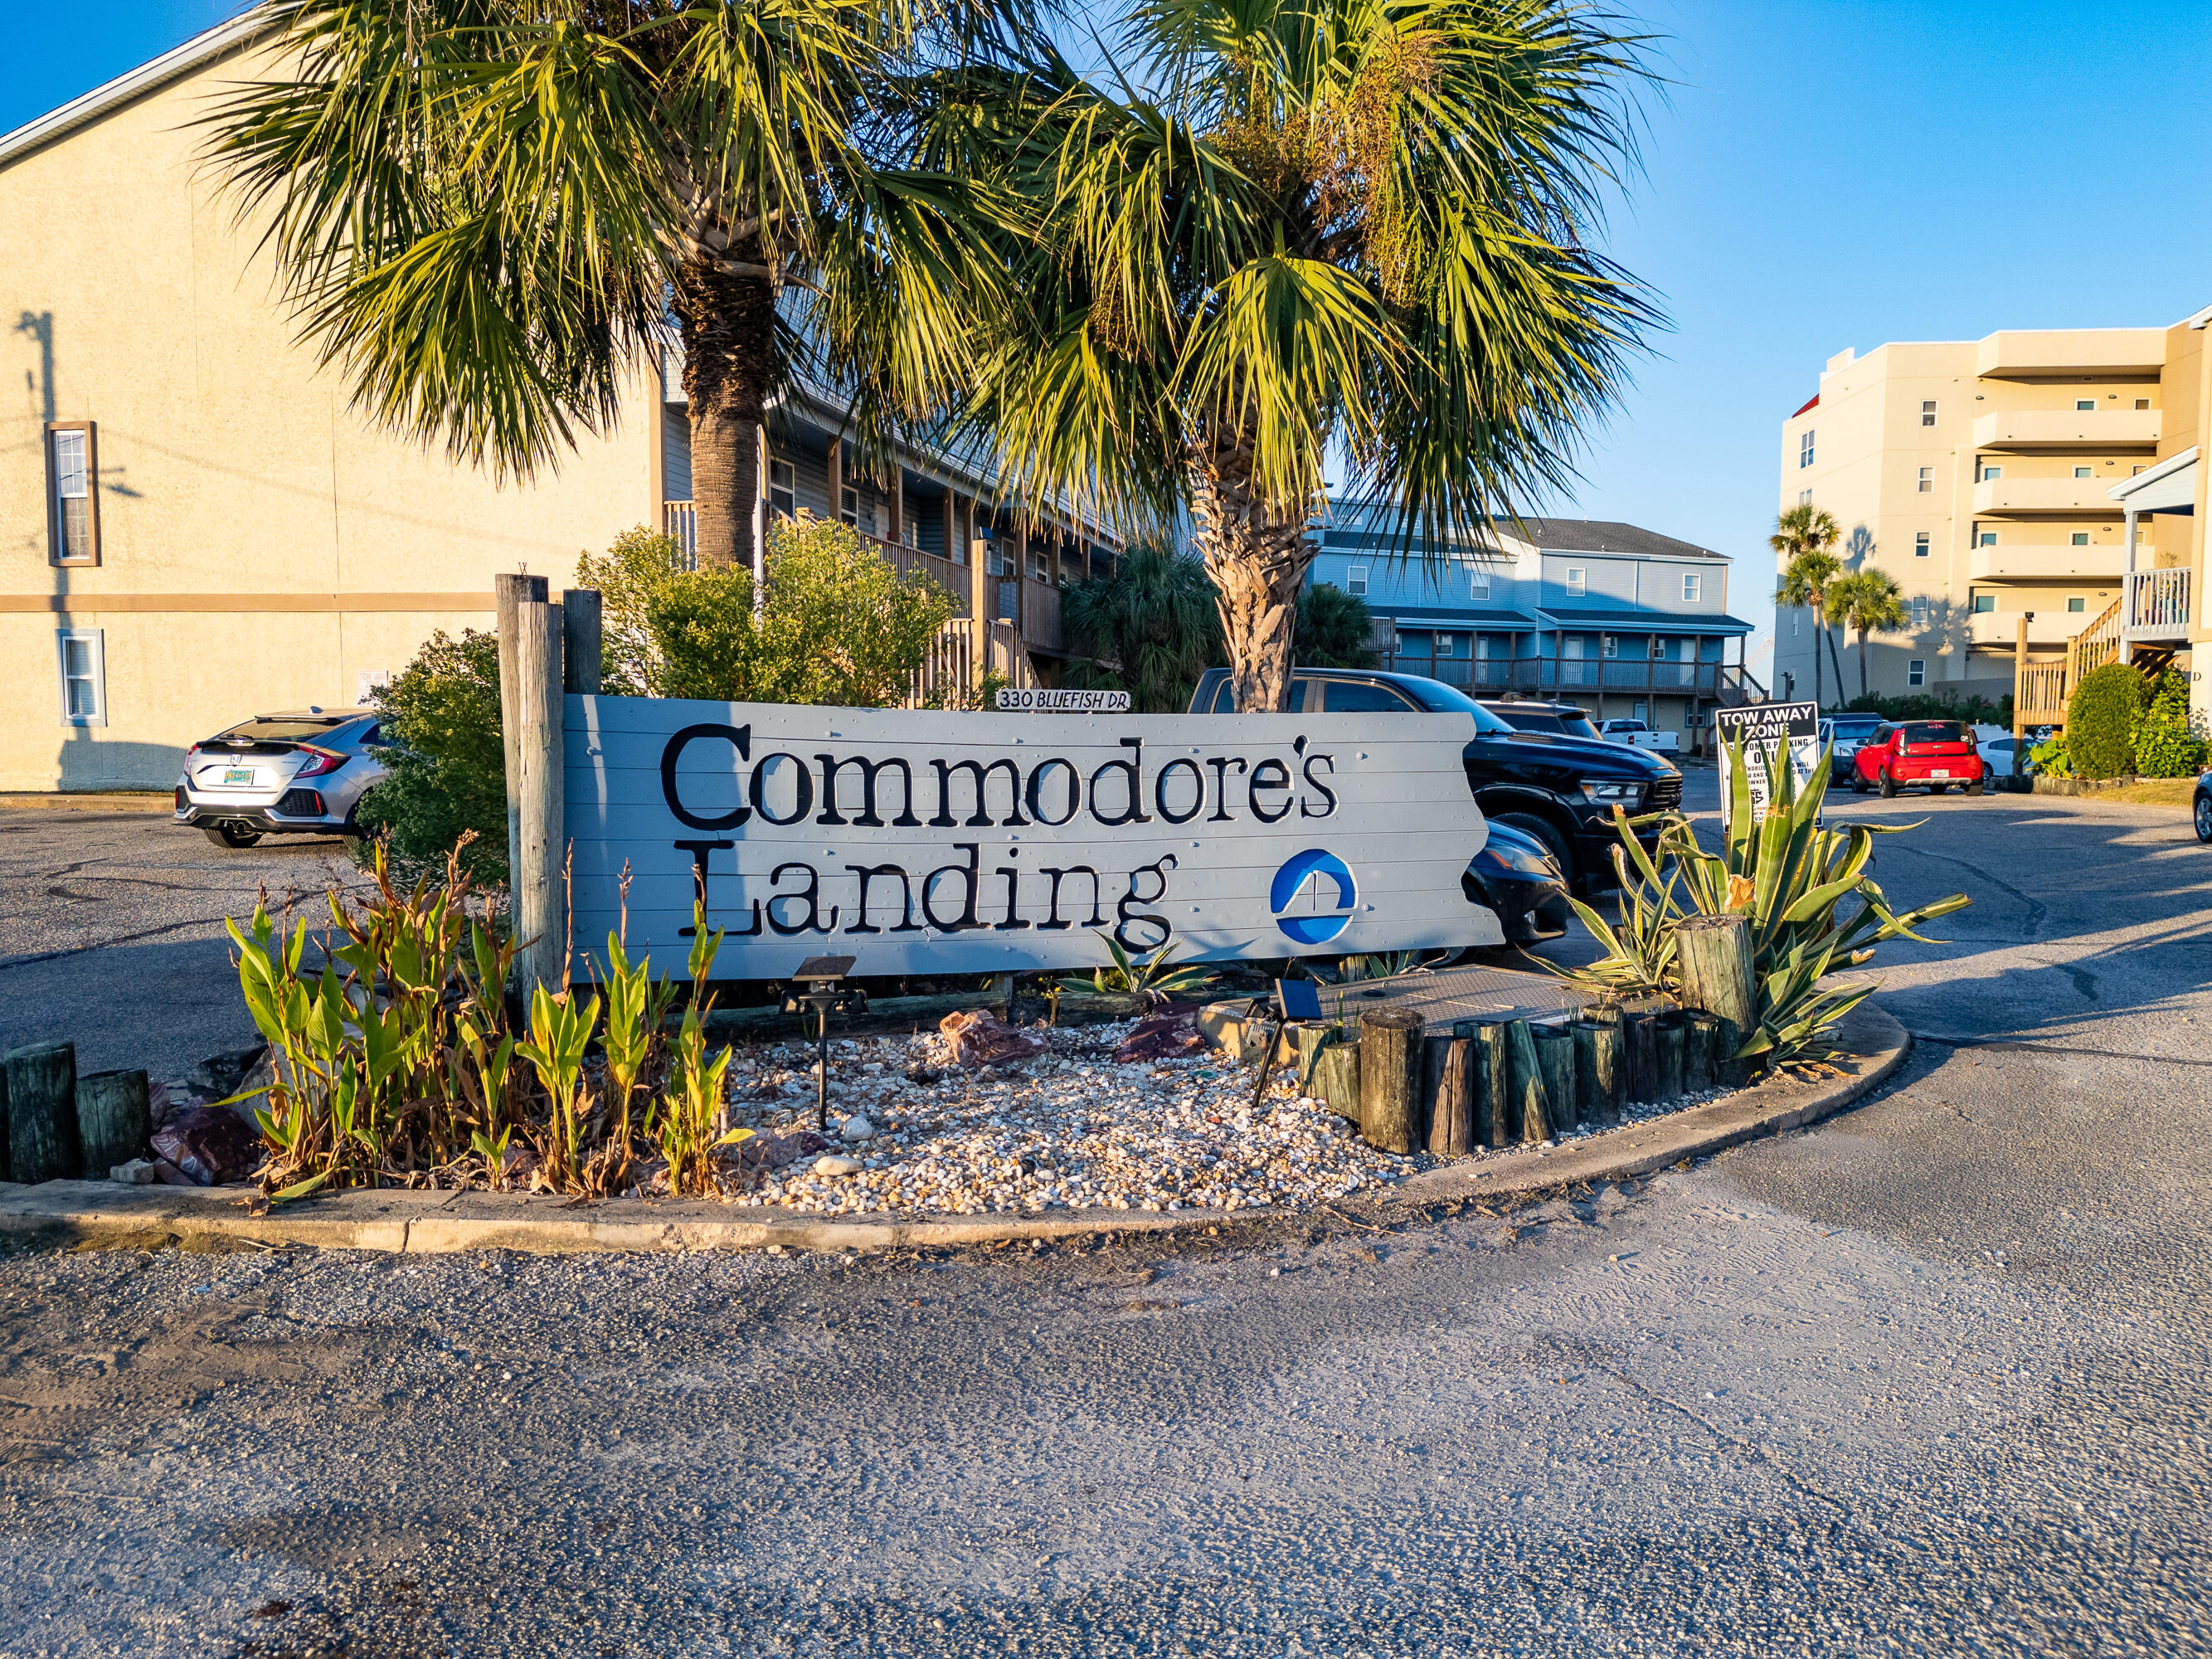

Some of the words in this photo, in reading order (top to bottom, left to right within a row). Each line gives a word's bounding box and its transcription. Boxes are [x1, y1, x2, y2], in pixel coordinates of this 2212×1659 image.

[999, 691, 1033, 708] 330
[1037, 691, 1105, 708] BLUEFISH
[1107, 692, 1130, 709] DR.
[1721, 711, 1759, 727] TOW
[1762, 706, 1812, 723] AWAY
[1773, 738, 1809, 749] PKING
[659, 721, 1339, 832] Commodore's
[672, 839, 1181, 955] Landing
